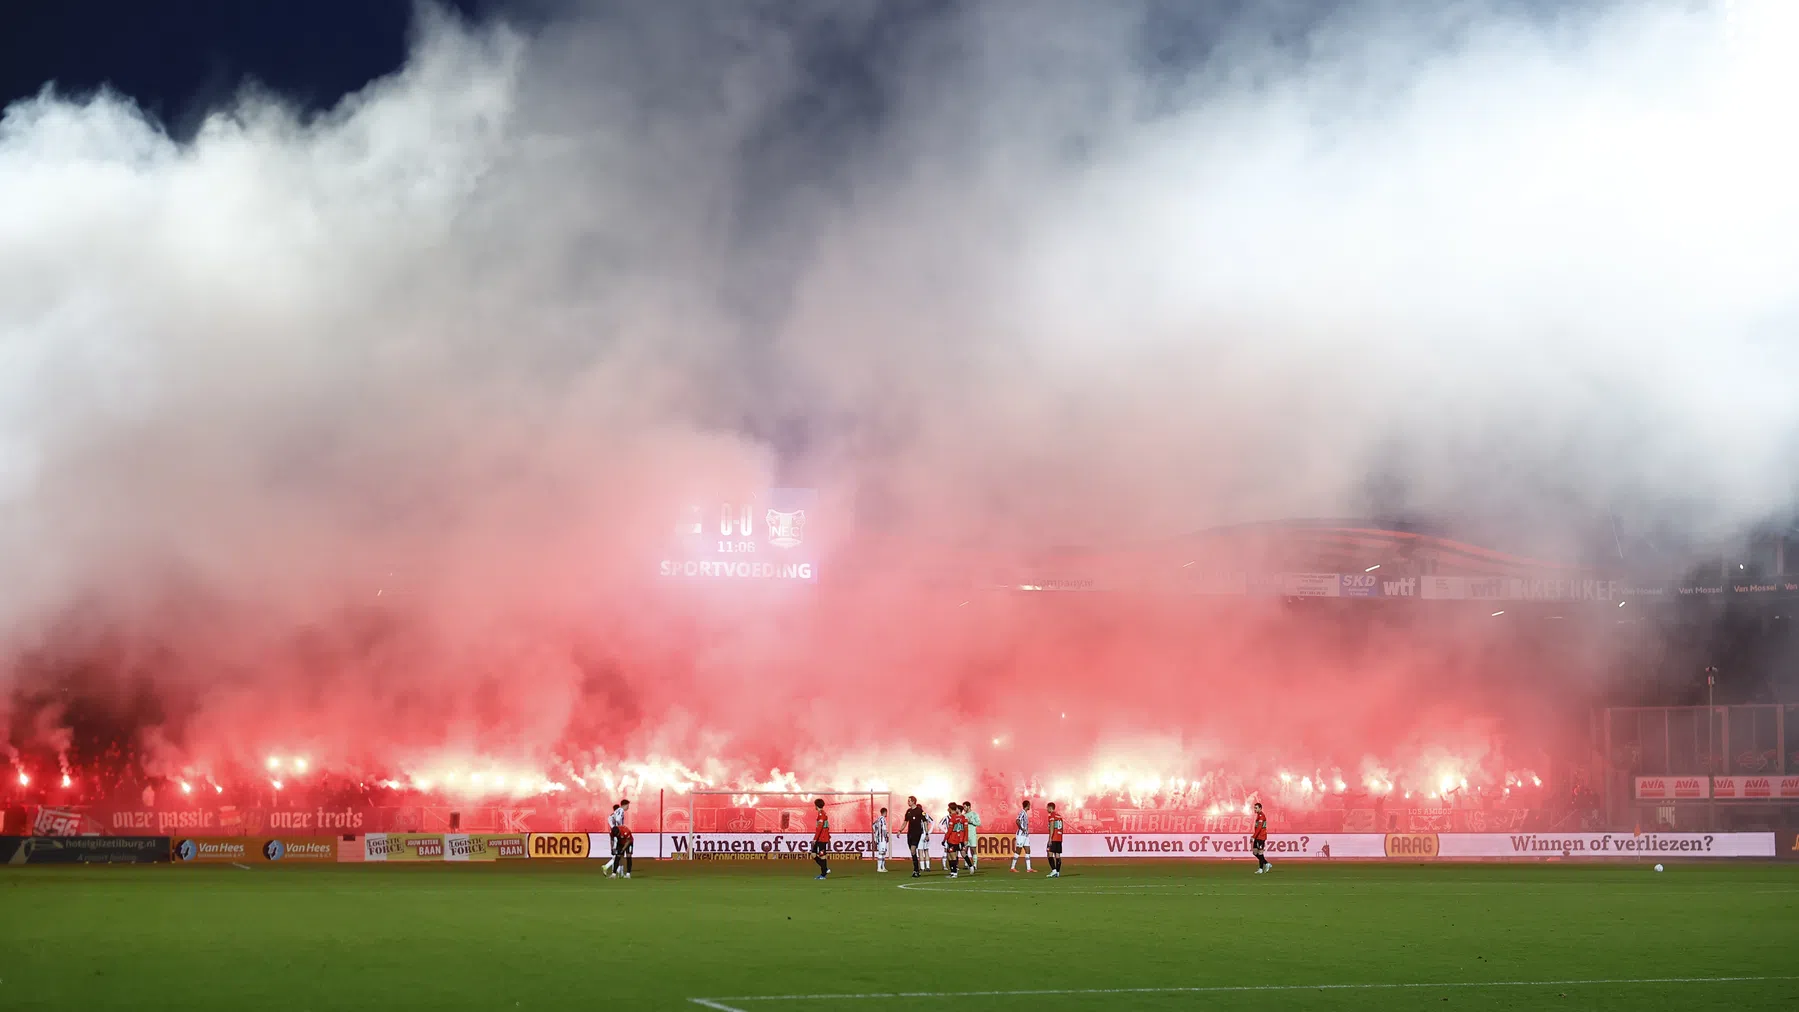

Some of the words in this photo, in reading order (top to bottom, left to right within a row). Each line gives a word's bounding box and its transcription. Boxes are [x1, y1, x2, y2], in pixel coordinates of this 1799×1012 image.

[772, 526, 799, 536] NEC
[660, 561, 811, 578] SPORTVOEDING
[1342, 574, 1376, 587] SKD
[1383, 577, 1416, 597] wtf
[1679, 587, 1694, 595] Van
[1695, 586, 1723, 594] Mossel
[1734, 585, 1749, 593] Van
[1750, 584, 1777, 592] Mossel
[1785, 583, 1799, 591] Van
[113, 811, 153, 828] onze
[159, 807, 213, 834] passie
[270, 811, 312, 828] onze
[316, 806, 364, 829] trots
[1120, 815, 1197, 832] TILBURG
[65, 839, 156, 849] hotelgilzetilburg.nl
[199, 843, 219, 852] Van
[219, 843, 244, 853] Hees
[286, 843, 305, 852] Van
[306, 843, 330, 853] Hees
[368, 838, 400, 847] LOGISTIC
[450, 838, 483, 847] LOGISTIC
[535, 837, 583, 853] ARAG
[671, 835, 755, 851] Winnen
[761, 835, 783, 851] of
[1105, 836, 1185, 851] Winnen
[1189, 835, 1209, 851] of
[1391, 837, 1432, 853] ARAG
[1510, 836, 1584, 852] Winnen
[1590, 836, 1610, 851] of
[1614, 835, 1713, 852] verliezen?
[369, 844, 403, 855] FORCE
[419, 846, 441, 855] BAAN
[452, 844, 485, 856] FORCE
[501, 846, 522, 855] BAAN
